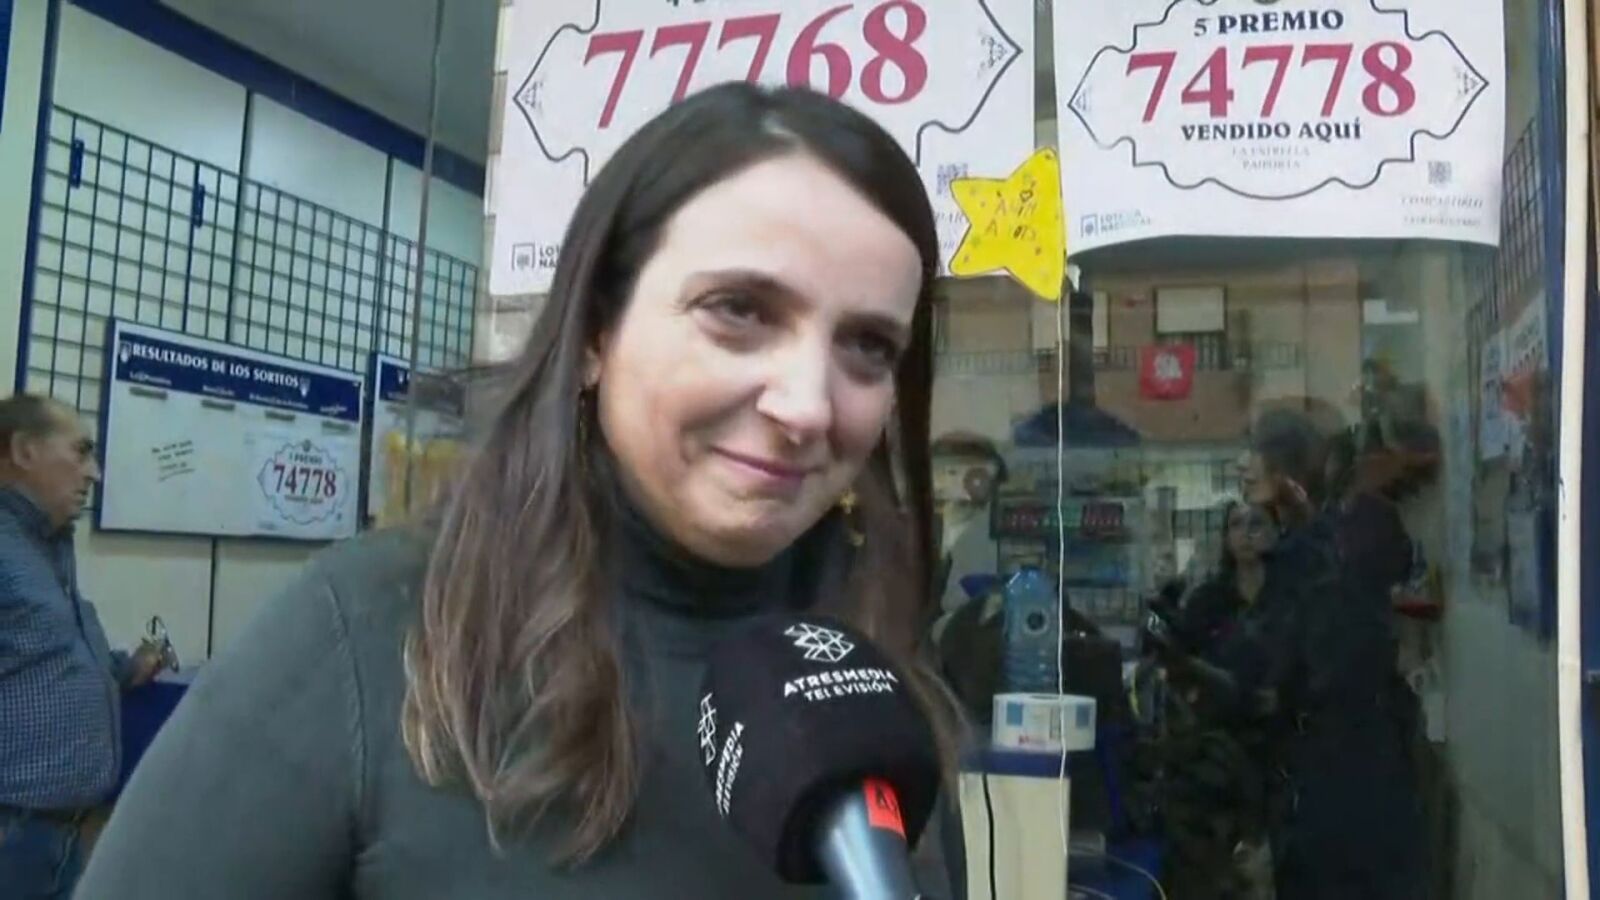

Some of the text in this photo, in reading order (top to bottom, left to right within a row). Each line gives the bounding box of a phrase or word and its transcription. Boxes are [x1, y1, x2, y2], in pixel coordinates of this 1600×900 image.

[1194, 9, 1344, 37] 5 PREMIO
[583, 0, 928, 129] 77768
[1125, 41, 1416, 123] 74778
[1181, 117, 1362, 142] VENDIDO AQUÍ
[133, 343, 299, 389] RESULTADOS DE LOS SORTEOS
[273, 464, 337, 498] 74778
[784, 667, 899, 698] ATRESMEDIA
[804, 680, 893, 702] TELEVISIÓN
